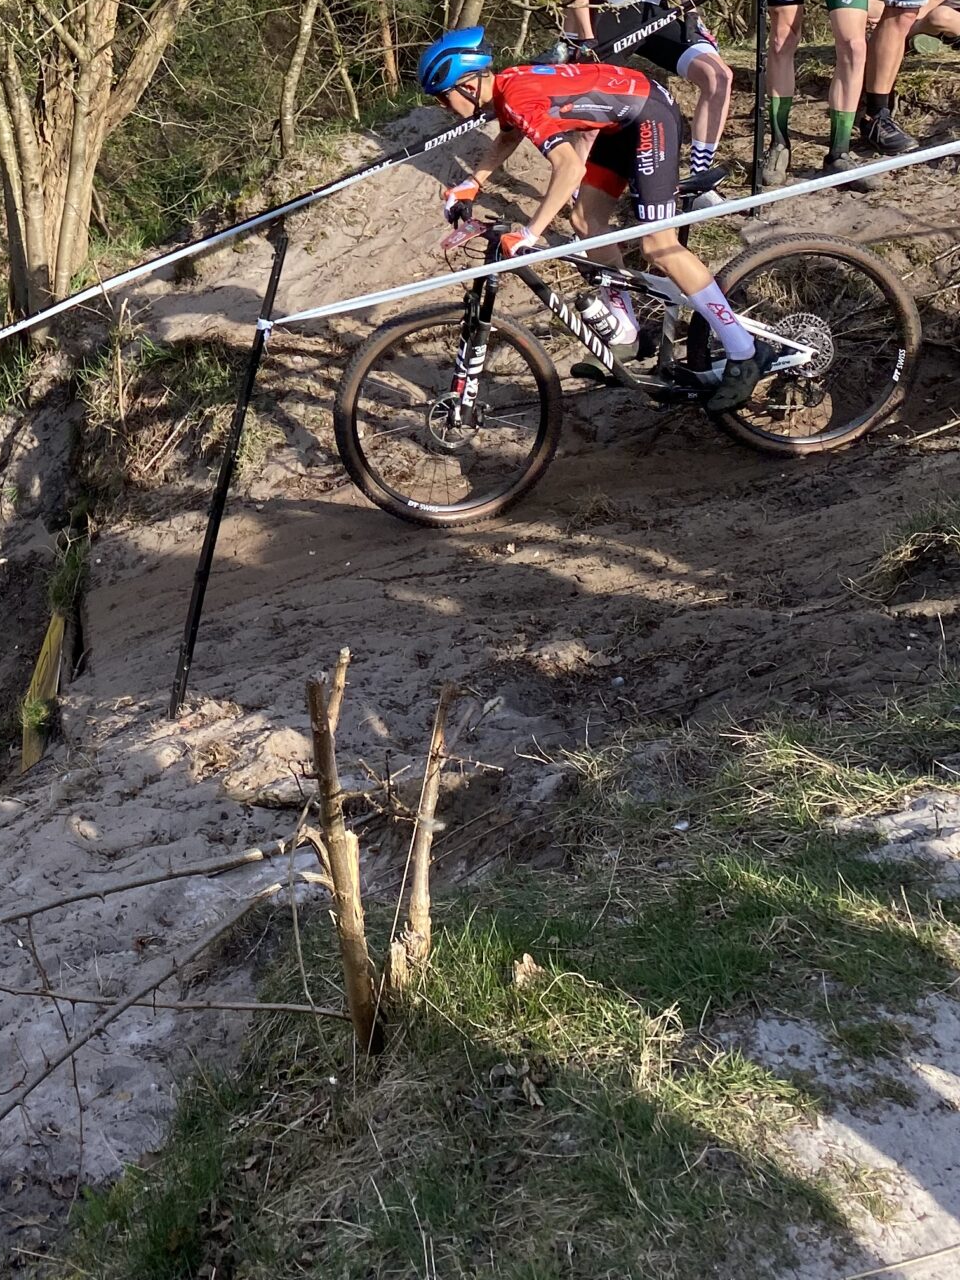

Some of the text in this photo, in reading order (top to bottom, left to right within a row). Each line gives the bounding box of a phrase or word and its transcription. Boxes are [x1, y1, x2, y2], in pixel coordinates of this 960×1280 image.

[613, 10, 678, 53] SPECIALIZED
[424, 112, 487, 152] SPECIALIZED
[706, 302, 736, 325] ACT
[549, 292, 614, 370] CANYON
[892, 348, 906, 382] DT SWISS
[462, 376, 479, 407] FOX
[407, 499, 420, 508] DT
